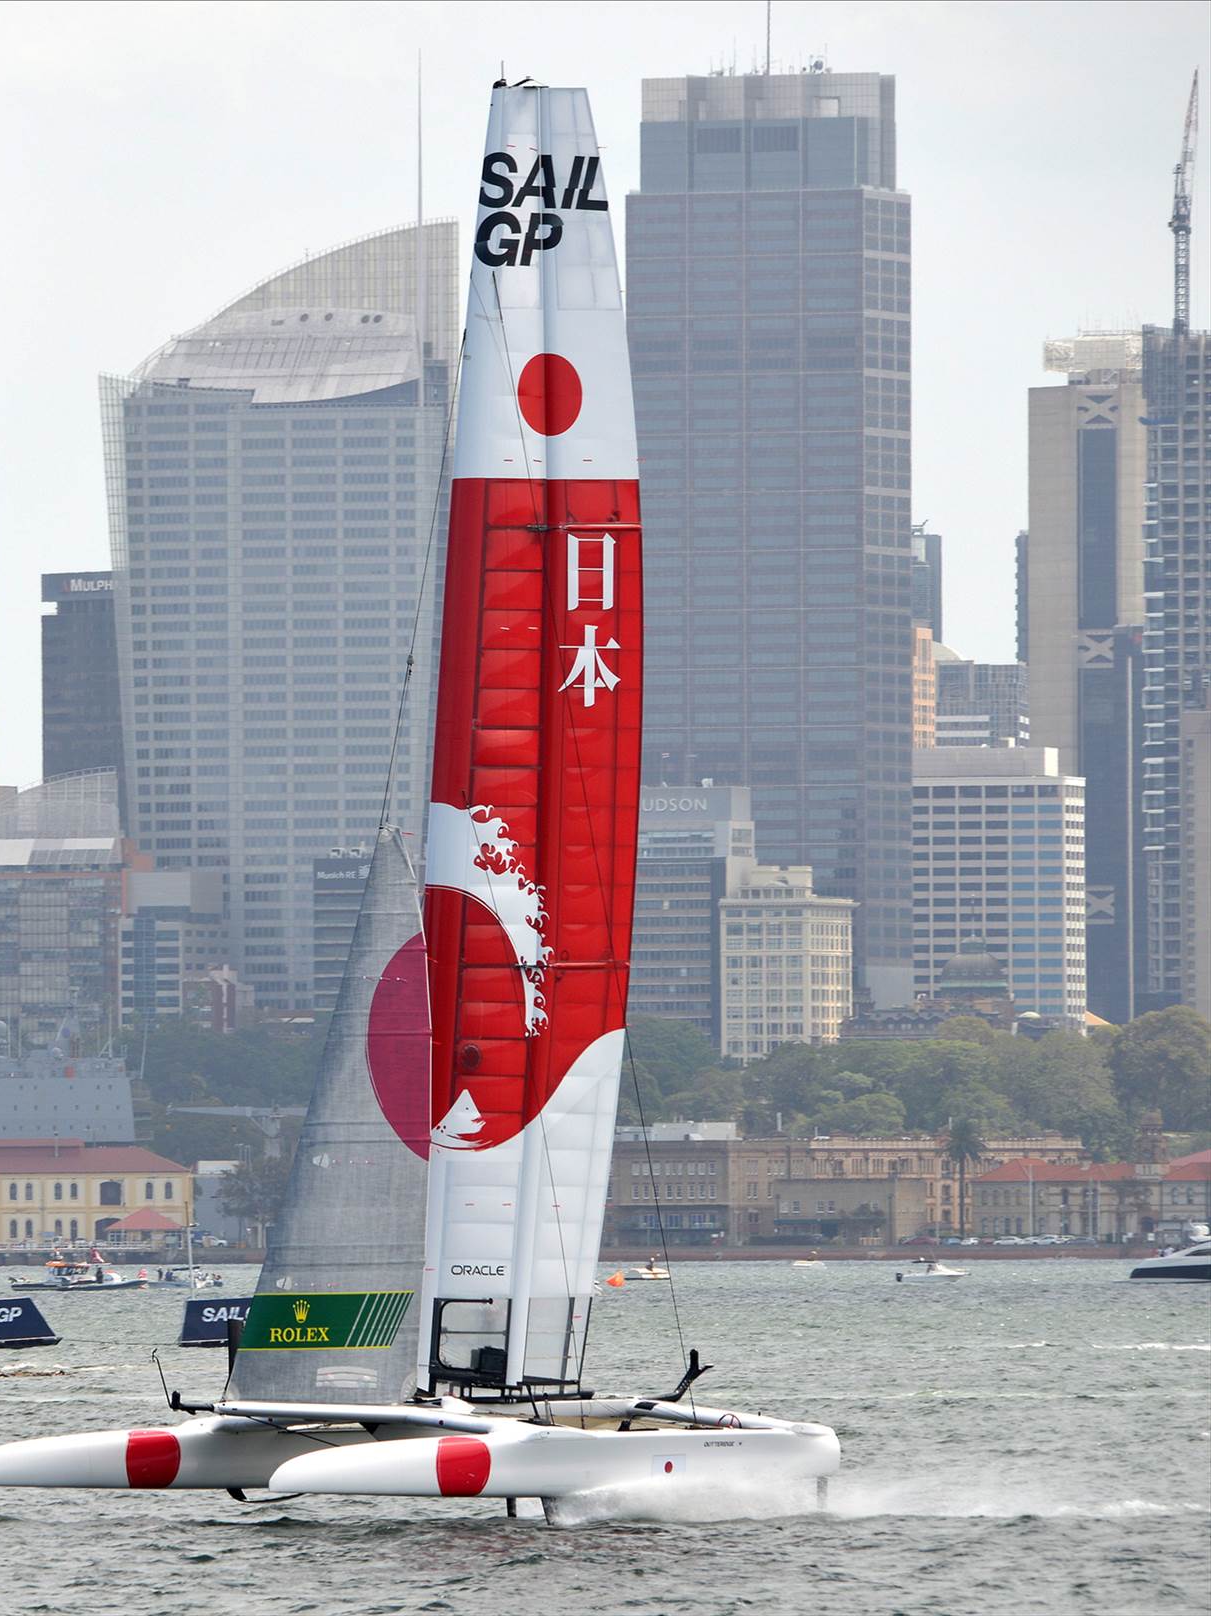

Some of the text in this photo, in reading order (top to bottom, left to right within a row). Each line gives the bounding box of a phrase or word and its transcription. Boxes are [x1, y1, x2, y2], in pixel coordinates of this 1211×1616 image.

[479, 152, 609, 211] SAIL
[474, 212, 564, 266] GP
[70, 579, 113, 592] MULPH
[558, 533, 621, 707] 日本
[641, 798, 707, 812] UDSON
[317, 871, 345, 880] Munich
[451, 1265, 505, 1276] ORACLE
[269, 1327, 330, 1343] ROLEX
